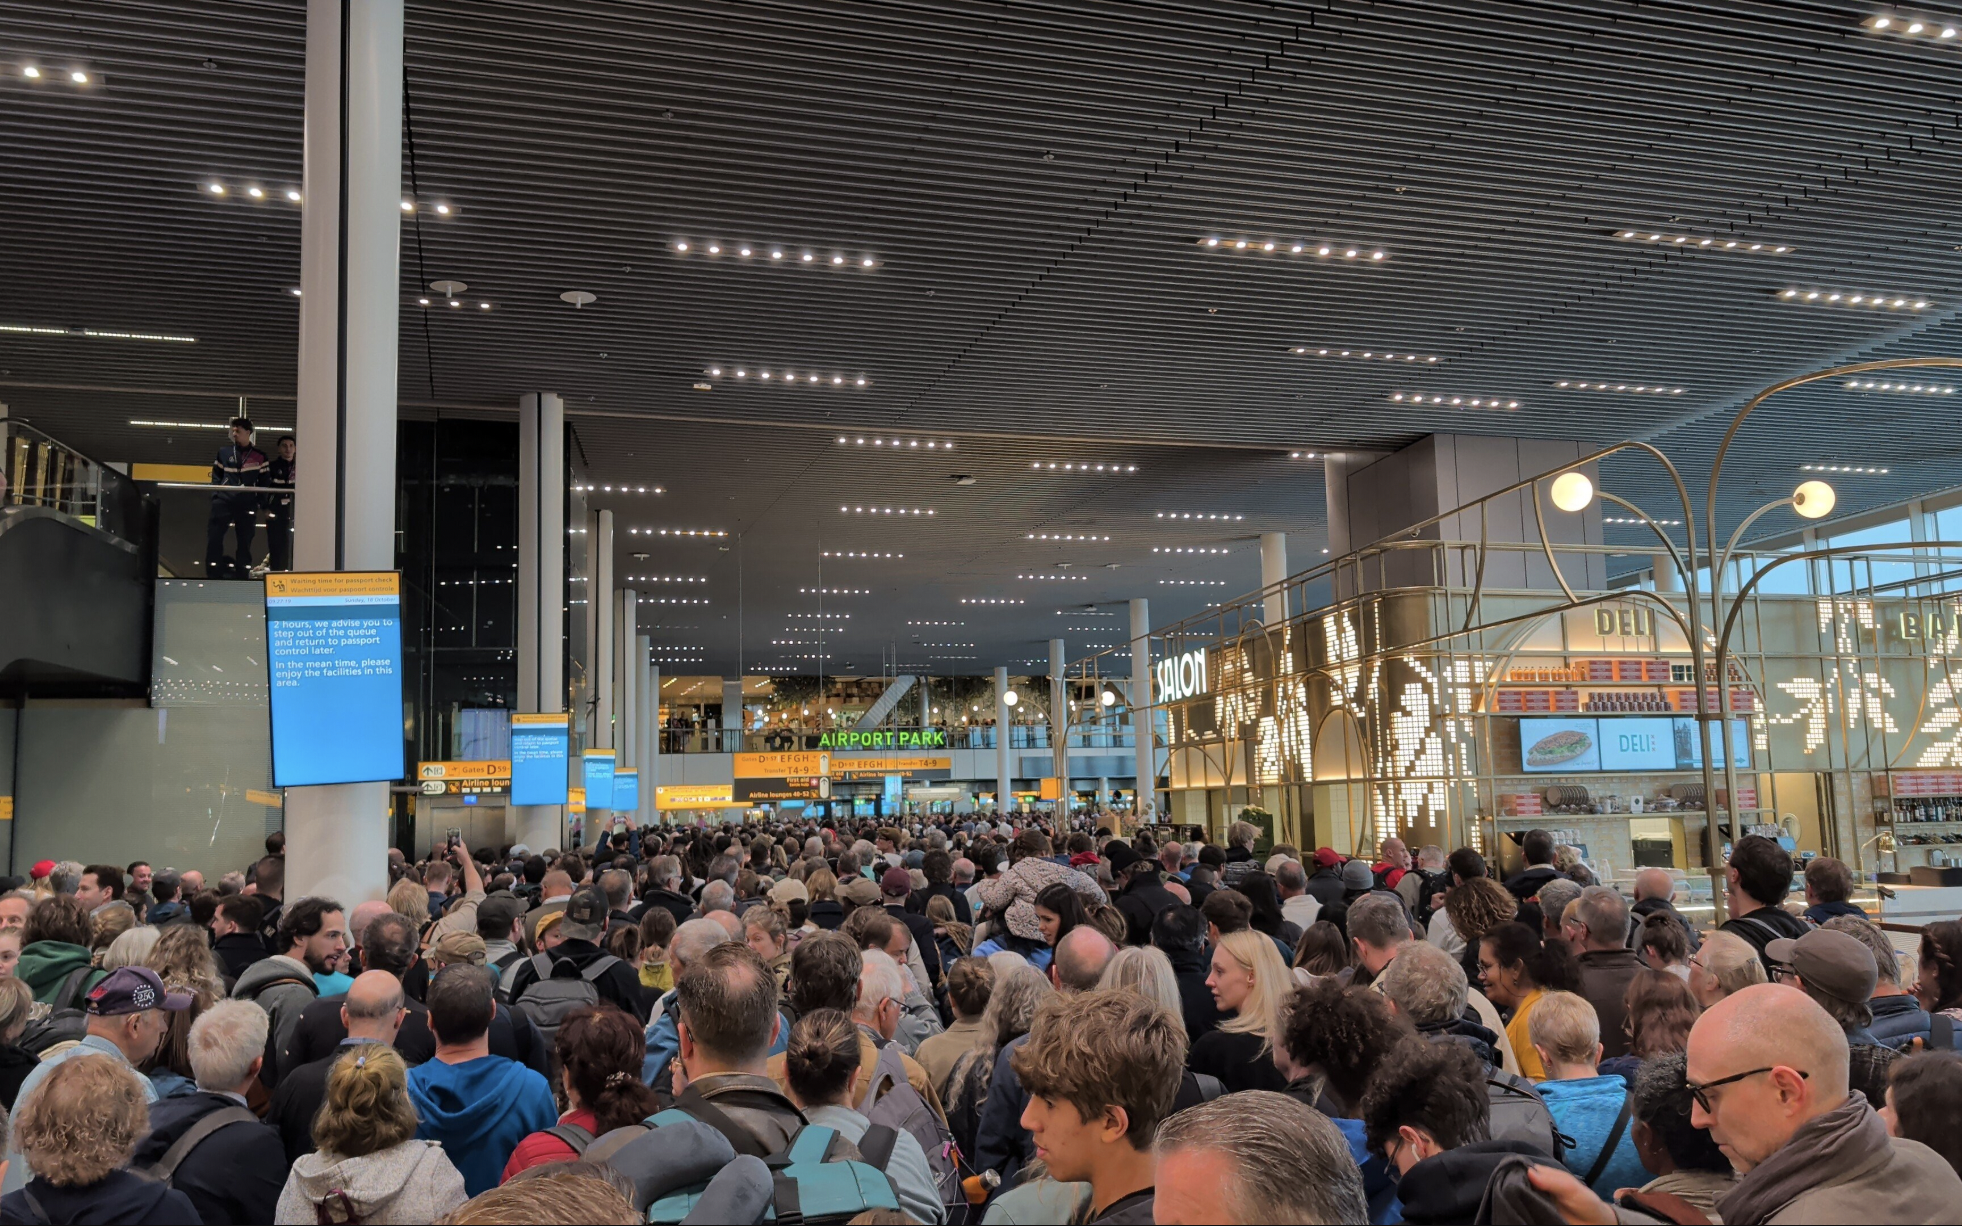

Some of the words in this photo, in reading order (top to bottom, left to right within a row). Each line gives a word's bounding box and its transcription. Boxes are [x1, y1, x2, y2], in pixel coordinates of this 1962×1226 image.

[282, 620, 312, 628] hours,
[363, 620, 380, 628] you
[1594, 608, 1655, 637] DELI
[1900, 612, 1962, 640] BA
[274, 630, 294, 638] step
[316, 628, 326, 636] of
[329, 628, 345, 636] the
[347, 628, 376, 637] queue
[274, 638, 293, 646] and
[341, 636, 380, 646] passport
[275, 647, 309, 655] control
[312, 646, 335, 654] later.
[288, 660, 304, 668] the
[335, 659, 359, 667] time,
[361, 658, 391, 668] please
[276, 670, 302, 679] enjoy
[305, 669, 320, 677] the
[323, 667, 362, 676] facilities
[376, 666, 392, 675] this
[1157, 647, 1206, 704] SALON
[820, 732, 893, 746] AIRPORT
[900, 731, 944, 746] PARK
[1619, 734, 1650, 752] DELI
[787, 766, 809, 774] T4-9
[137, 991, 155, 1001] 250
